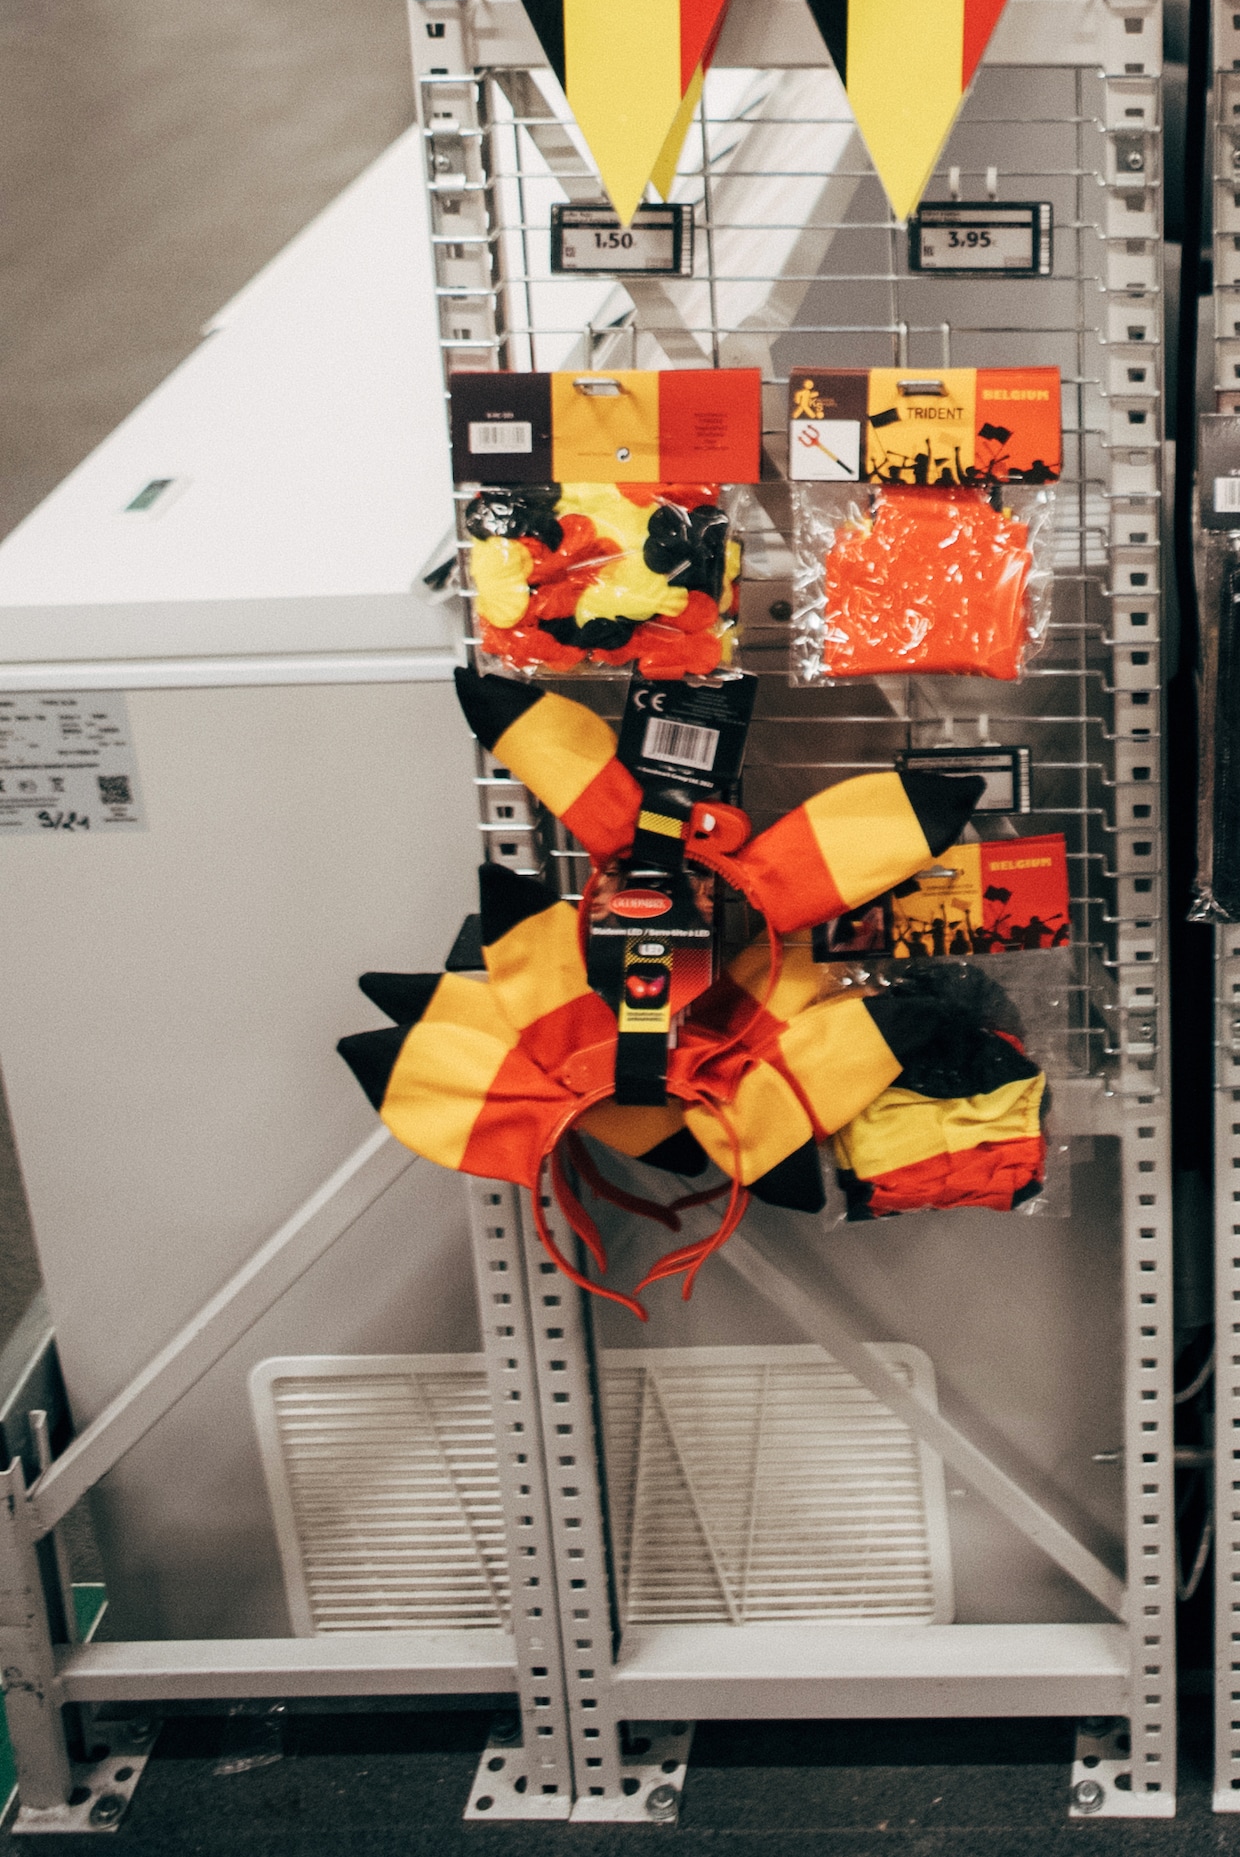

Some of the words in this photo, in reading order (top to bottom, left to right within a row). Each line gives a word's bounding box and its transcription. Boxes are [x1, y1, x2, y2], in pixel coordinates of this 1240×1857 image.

[982, 389, 1050, 402] BELGIUM
[906, 407, 964, 421] TRIDENT
[989, 857, 1053, 872] BELGIUM
[627, 928, 644, 937] LED
[695, 930, 711, 938] LED
[638, 943, 665, 956] LED
